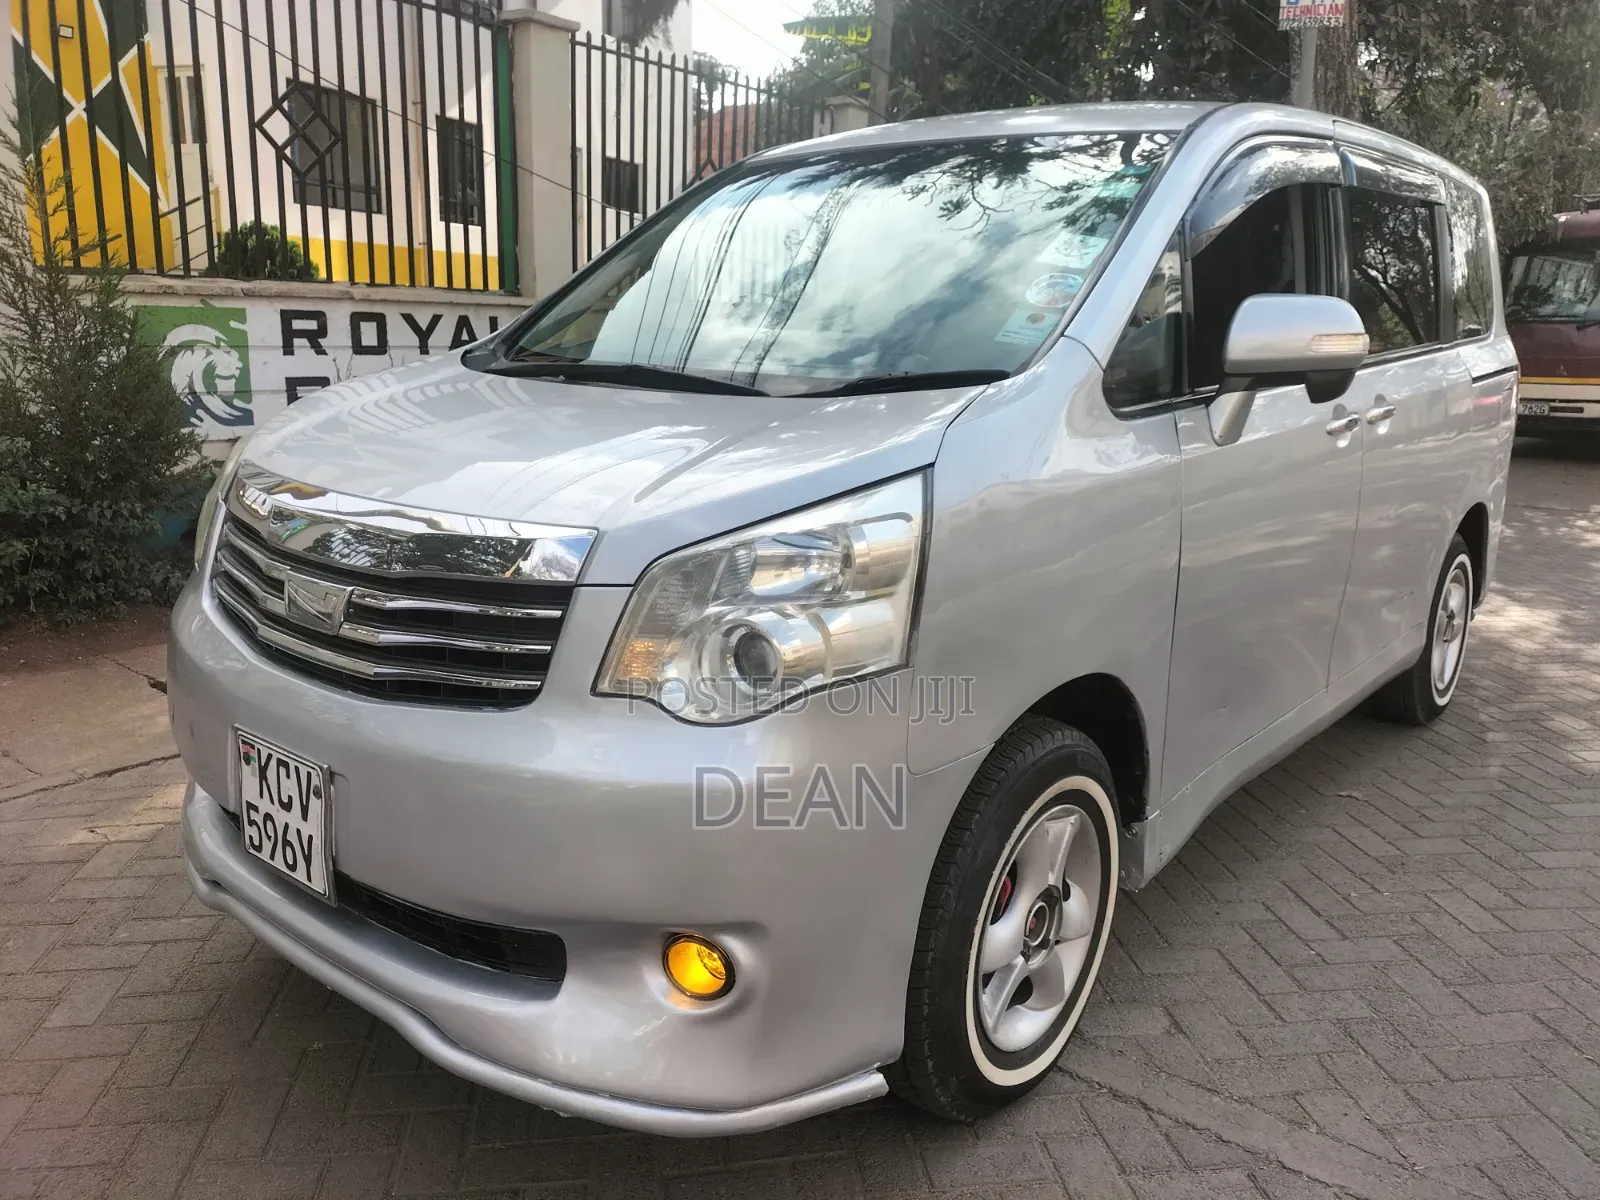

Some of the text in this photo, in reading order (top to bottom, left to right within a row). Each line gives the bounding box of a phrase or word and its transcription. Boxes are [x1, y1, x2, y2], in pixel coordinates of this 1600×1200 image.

[1279, 3, 1344, 18] TECHNICIAN
[256, 747, 312, 823] KCV
[246, 800, 313, 883] 596Y
